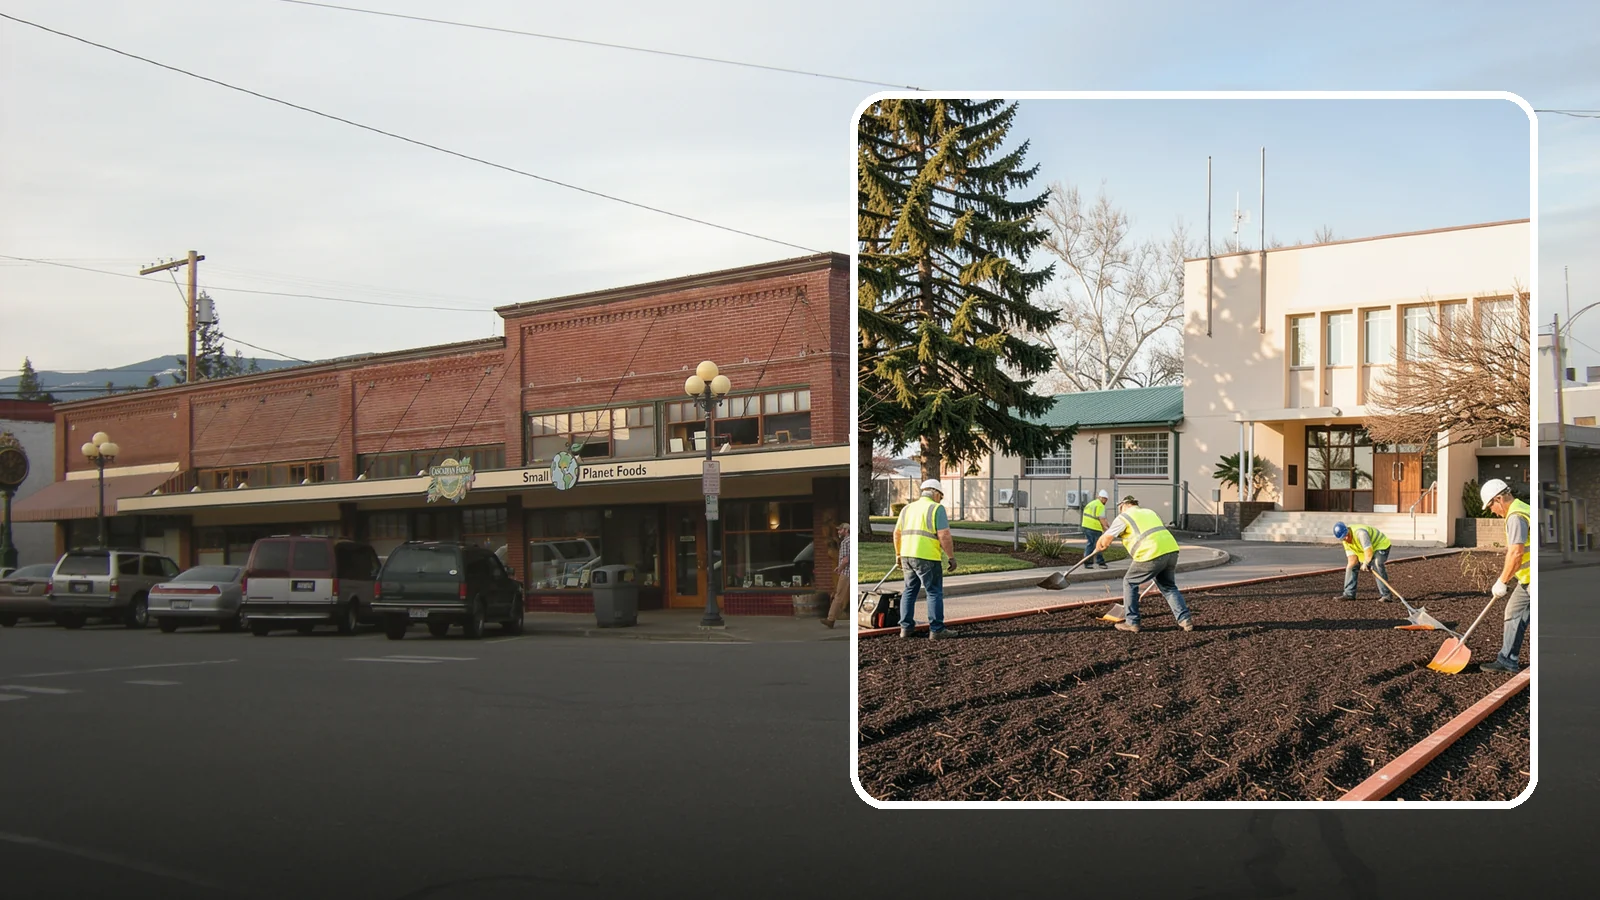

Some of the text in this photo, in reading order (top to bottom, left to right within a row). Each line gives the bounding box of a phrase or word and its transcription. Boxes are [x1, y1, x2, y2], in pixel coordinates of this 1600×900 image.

[523, 464, 647, 483] Small Planet Foods
